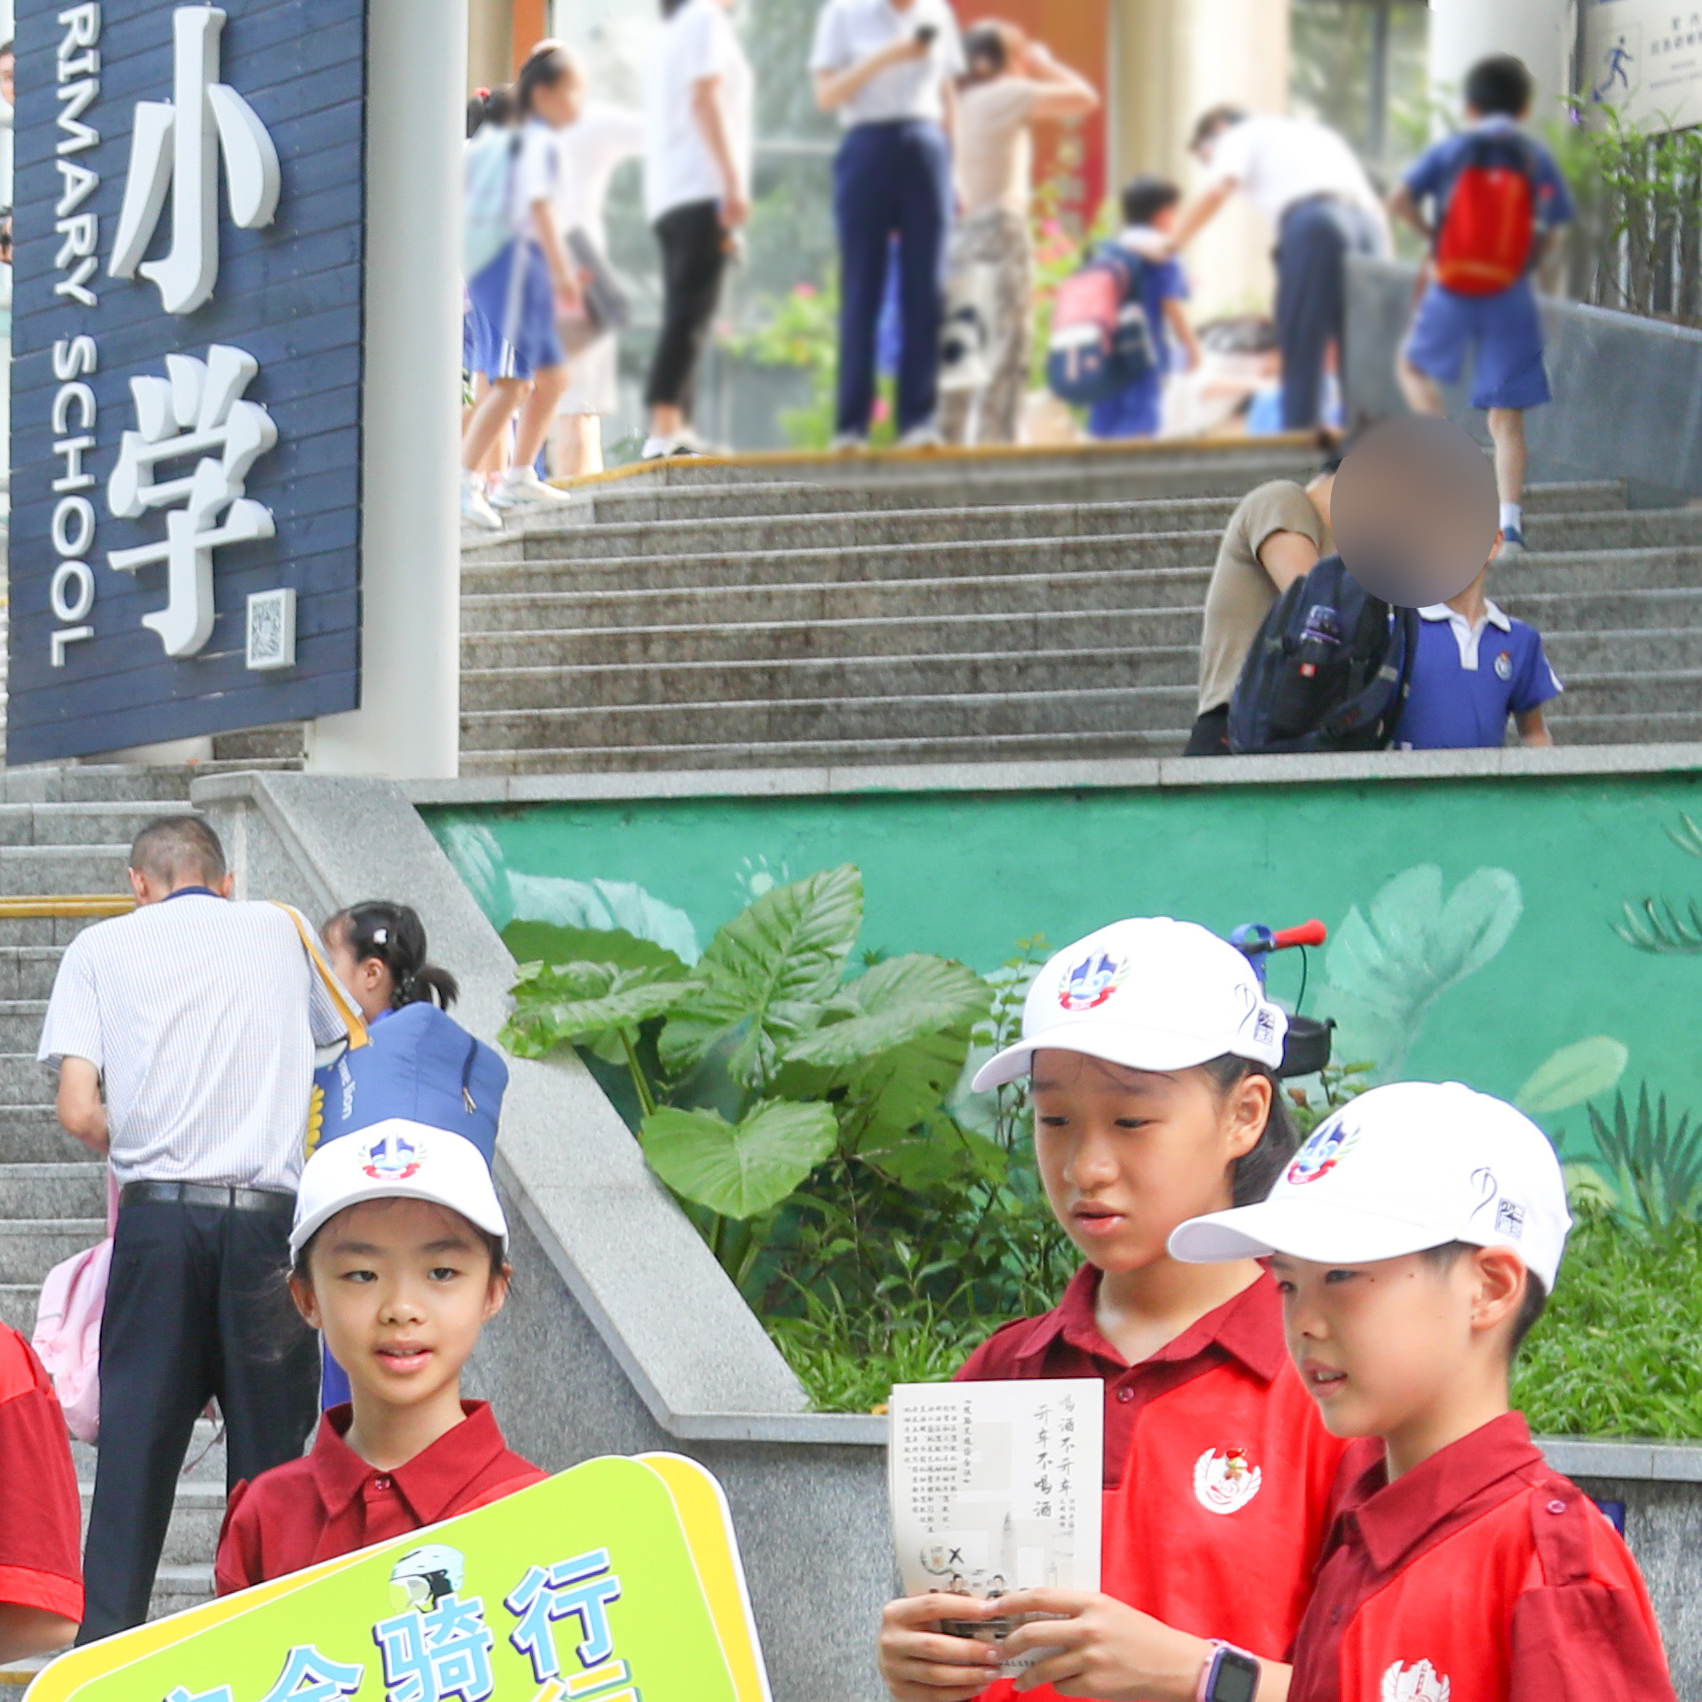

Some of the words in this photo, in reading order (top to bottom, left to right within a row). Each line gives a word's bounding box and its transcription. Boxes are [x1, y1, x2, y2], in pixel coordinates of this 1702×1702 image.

[53, 2, 100, 306] RIMARY
[108, 6, 283, 657] 小学
[50, 334, 98, 667] SCHOOL
[1033, 1404, 1054, 1518] 开车不喝酒
[1057, 1394, 1077, 1497] 喝酒不开车
